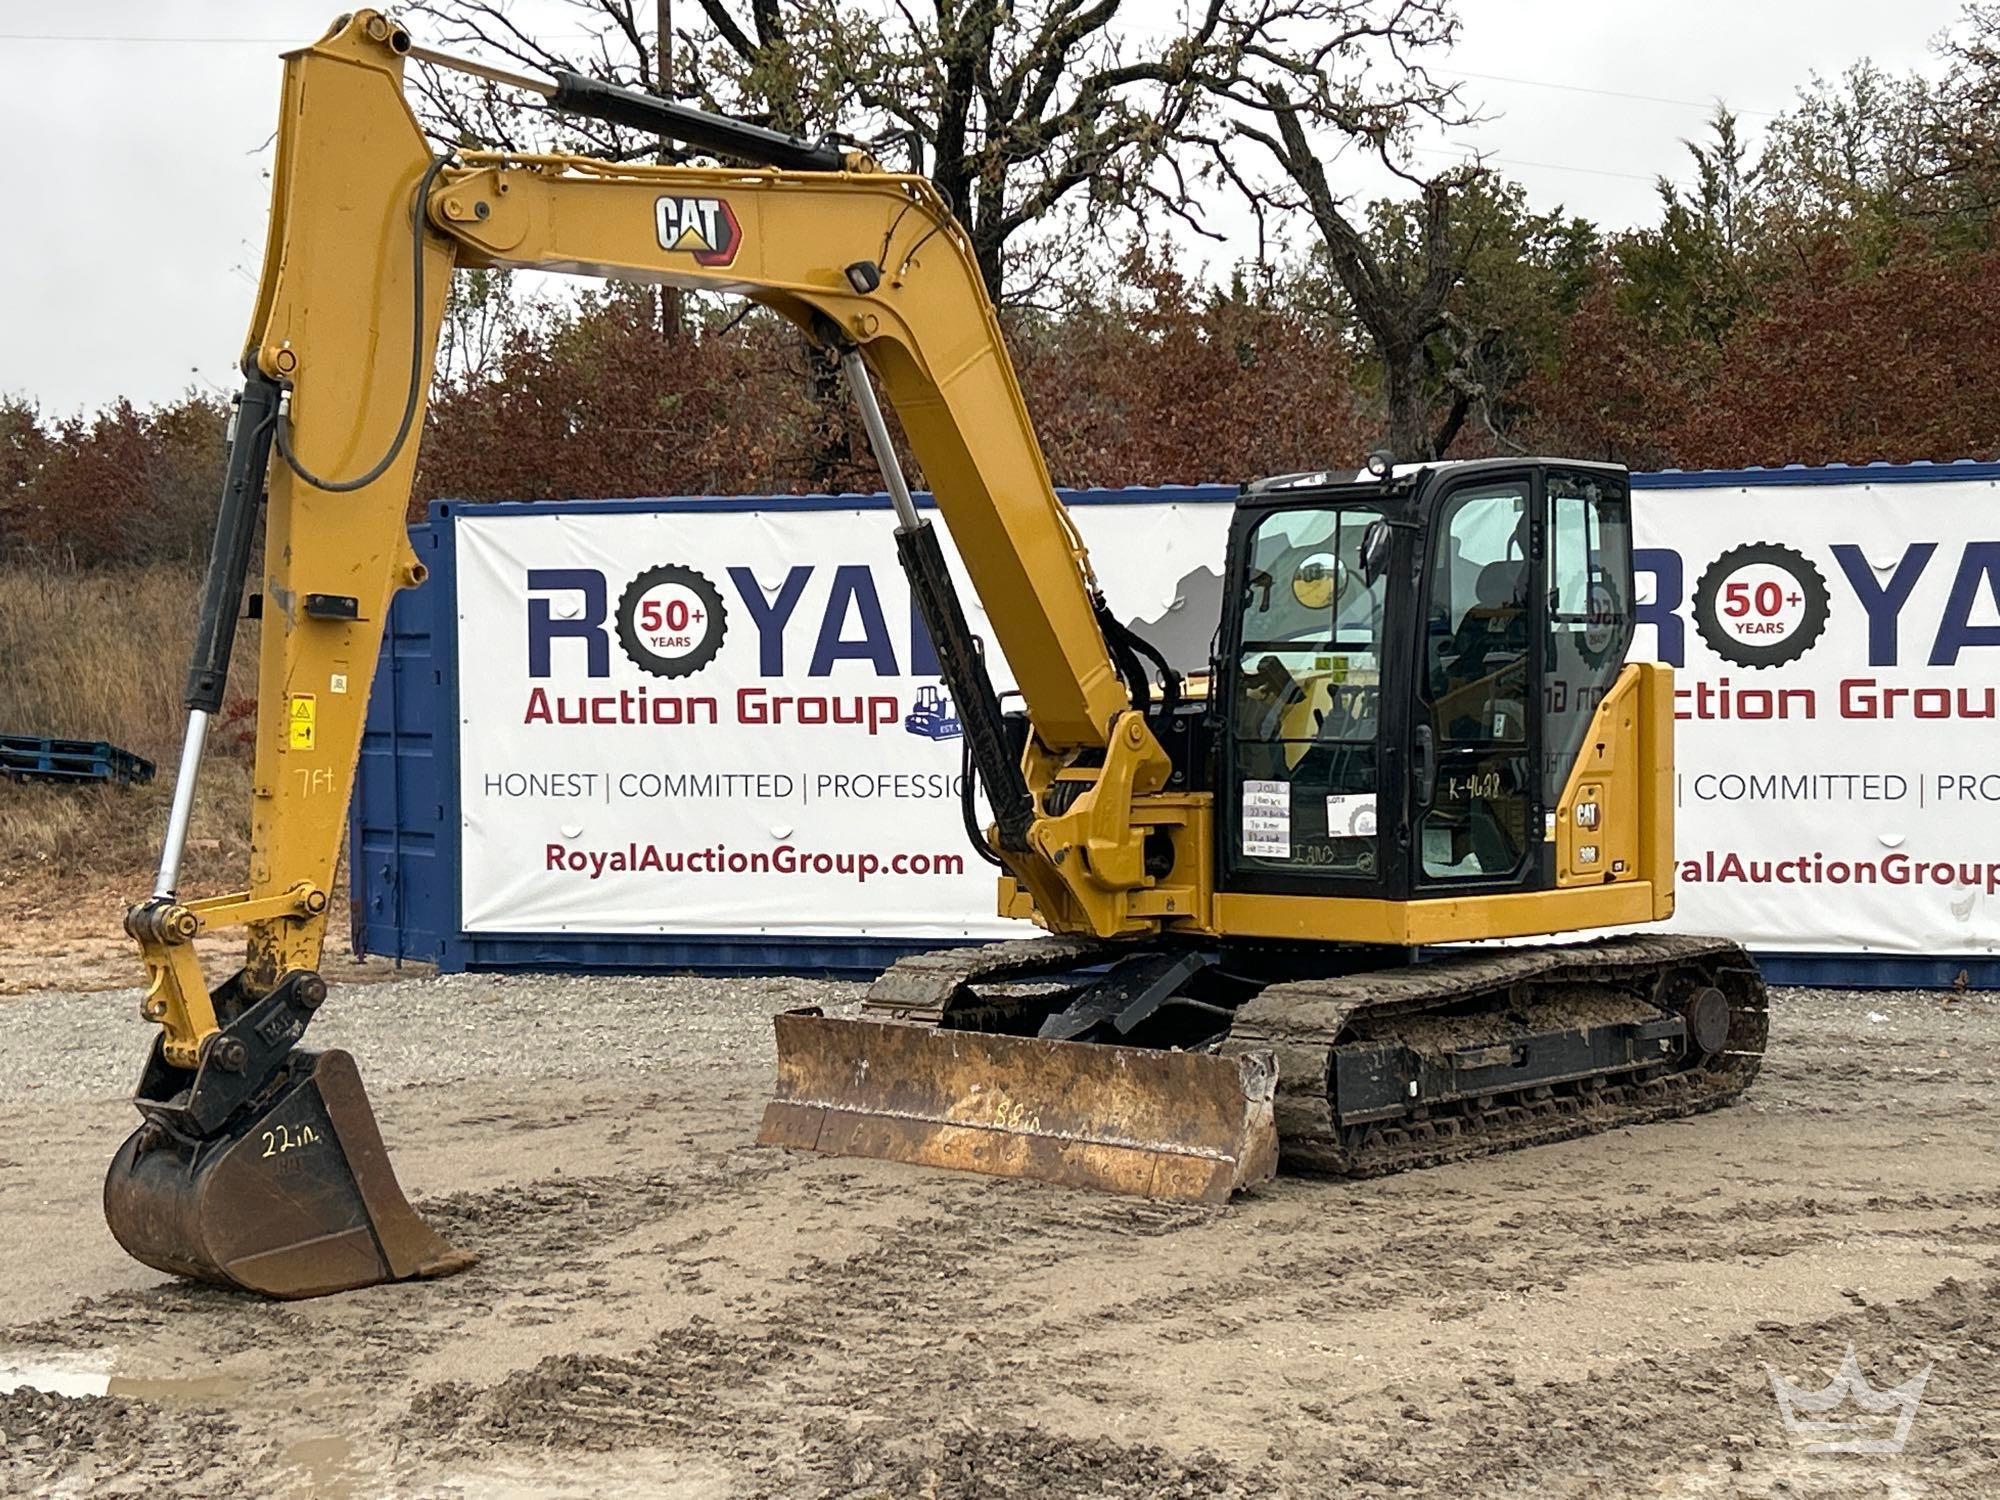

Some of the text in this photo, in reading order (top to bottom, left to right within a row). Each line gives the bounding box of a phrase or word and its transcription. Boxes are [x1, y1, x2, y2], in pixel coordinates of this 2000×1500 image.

[656, 197, 720, 251] CAT
[1723, 582, 1802, 618] 50+
[641, 600, 705, 631] 50+
[1735, 622, 1784, 634] YEARS
[650, 637, 691, 647] YEARS
[524, 687, 899, 735] Auction Group
[940, 724, 955, 734] EST.
[485, 774, 598, 798] HONEST
[619, 773, 793, 798] COMMITTED
[1449, 772, 1500, 800] K-4628
[1694, 774, 1907, 800] COMMITTED
[1576, 803, 1597, 828] CAT
[546, 844, 964, 882] RoyalAuctionGroup.com
[1675, 850, 2000, 895] alAuctionGroup
